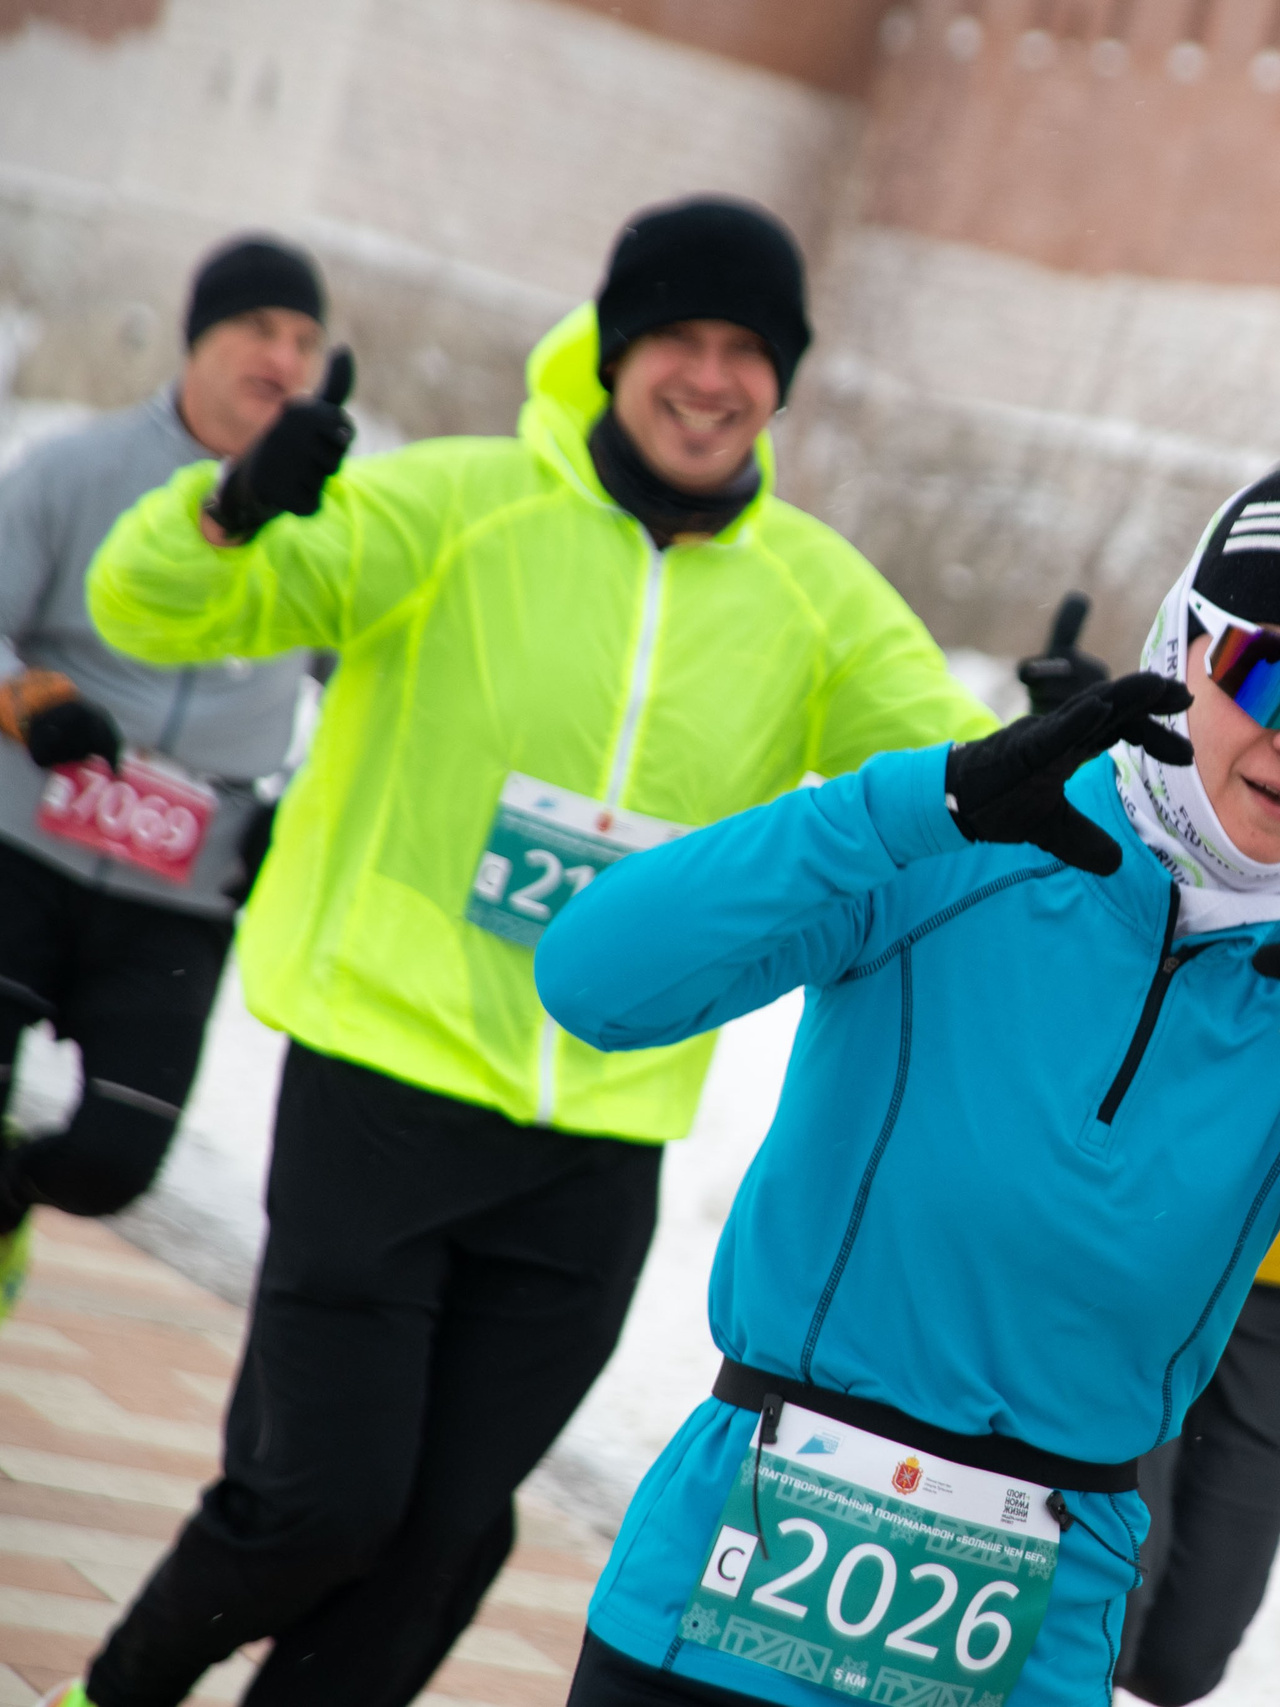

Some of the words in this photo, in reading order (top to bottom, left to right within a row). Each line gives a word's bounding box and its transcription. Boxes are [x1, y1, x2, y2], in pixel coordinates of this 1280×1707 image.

[71, 765, 200, 862] 7069
[508, 848, 597, 920] 21
[874, 1507, 955, 1543] ПОЛУМАРАФОН
[1003, 1546, 1023, 1560] ЧЕМ
[1024, 1550, 1047, 1564] БЕГ»
[752, 1518, 1020, 1672] 2026
